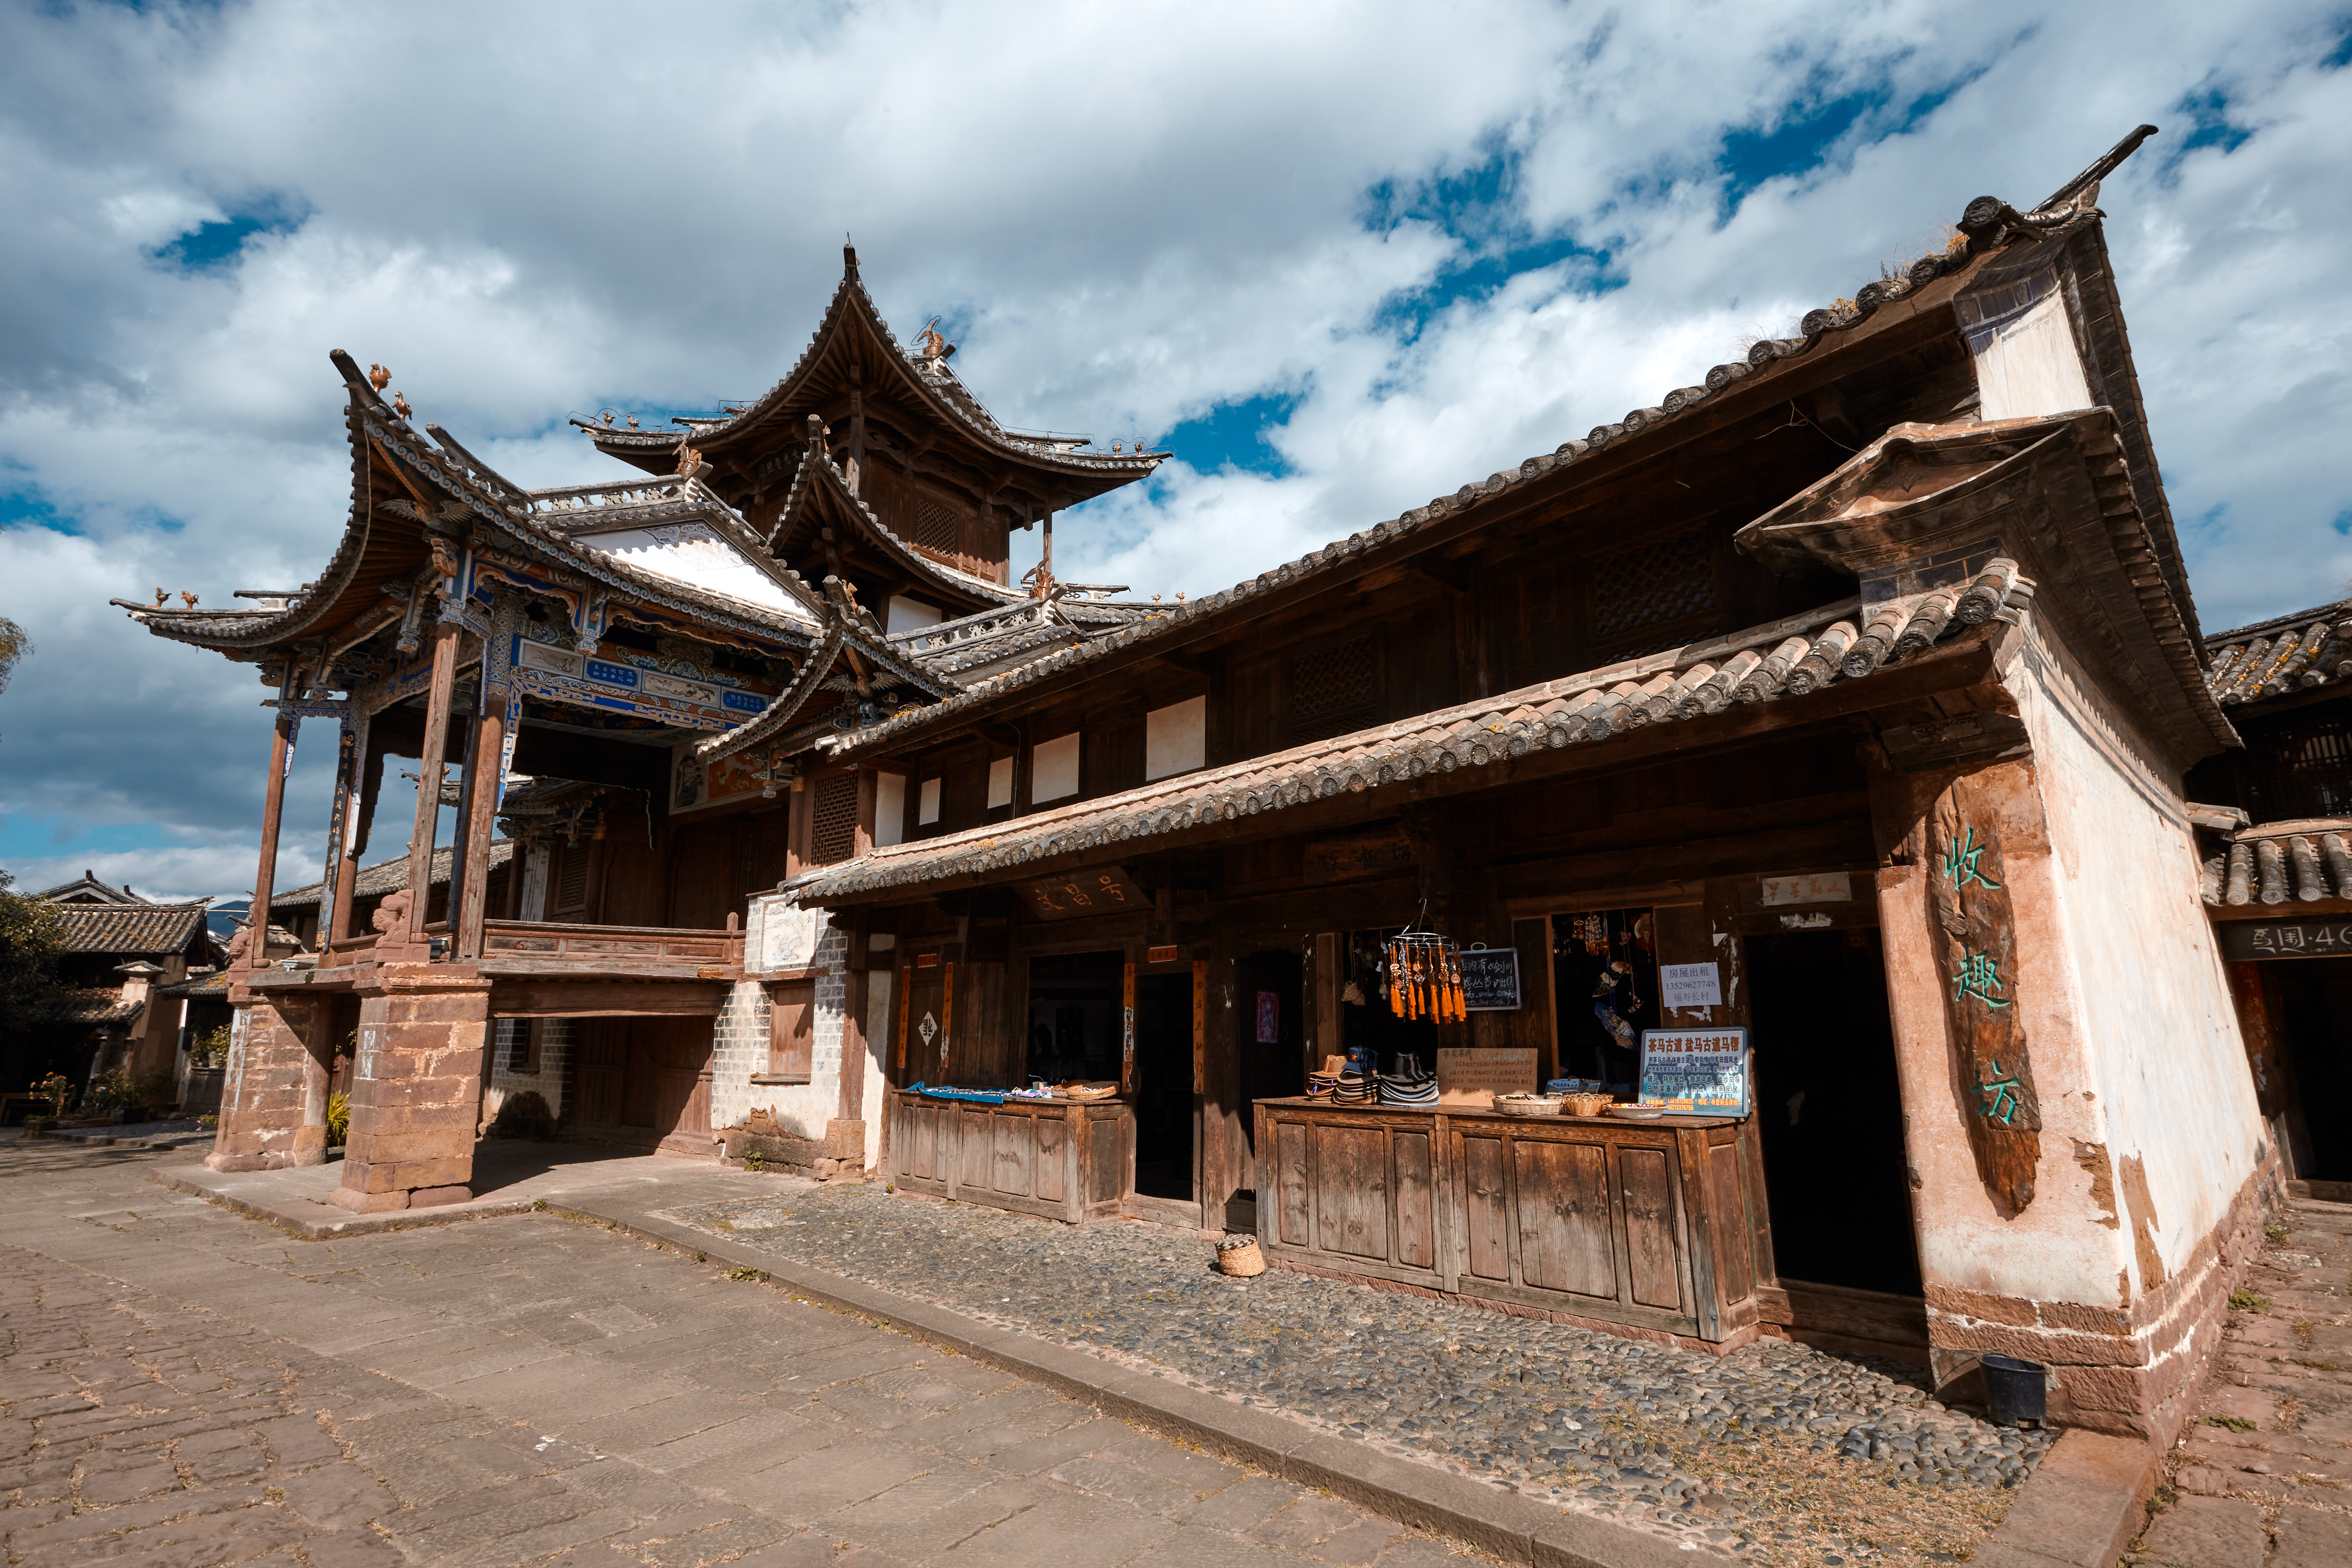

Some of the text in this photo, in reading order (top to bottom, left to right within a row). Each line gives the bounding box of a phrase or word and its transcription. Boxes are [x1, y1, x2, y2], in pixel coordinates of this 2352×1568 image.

[1036, 876, 1124, 910] 文昌号
[1669, 967, 1710, 978] 房屋出租
[1944, 827, 2021, 1125] 收趣坊
[1666, 980, 1716, 990] 13529627748
[1674, 991, 1710, 1002] 福寿长村
[1648, 1037, 1739, 1052] 茶马古道 盐马古道马帮
